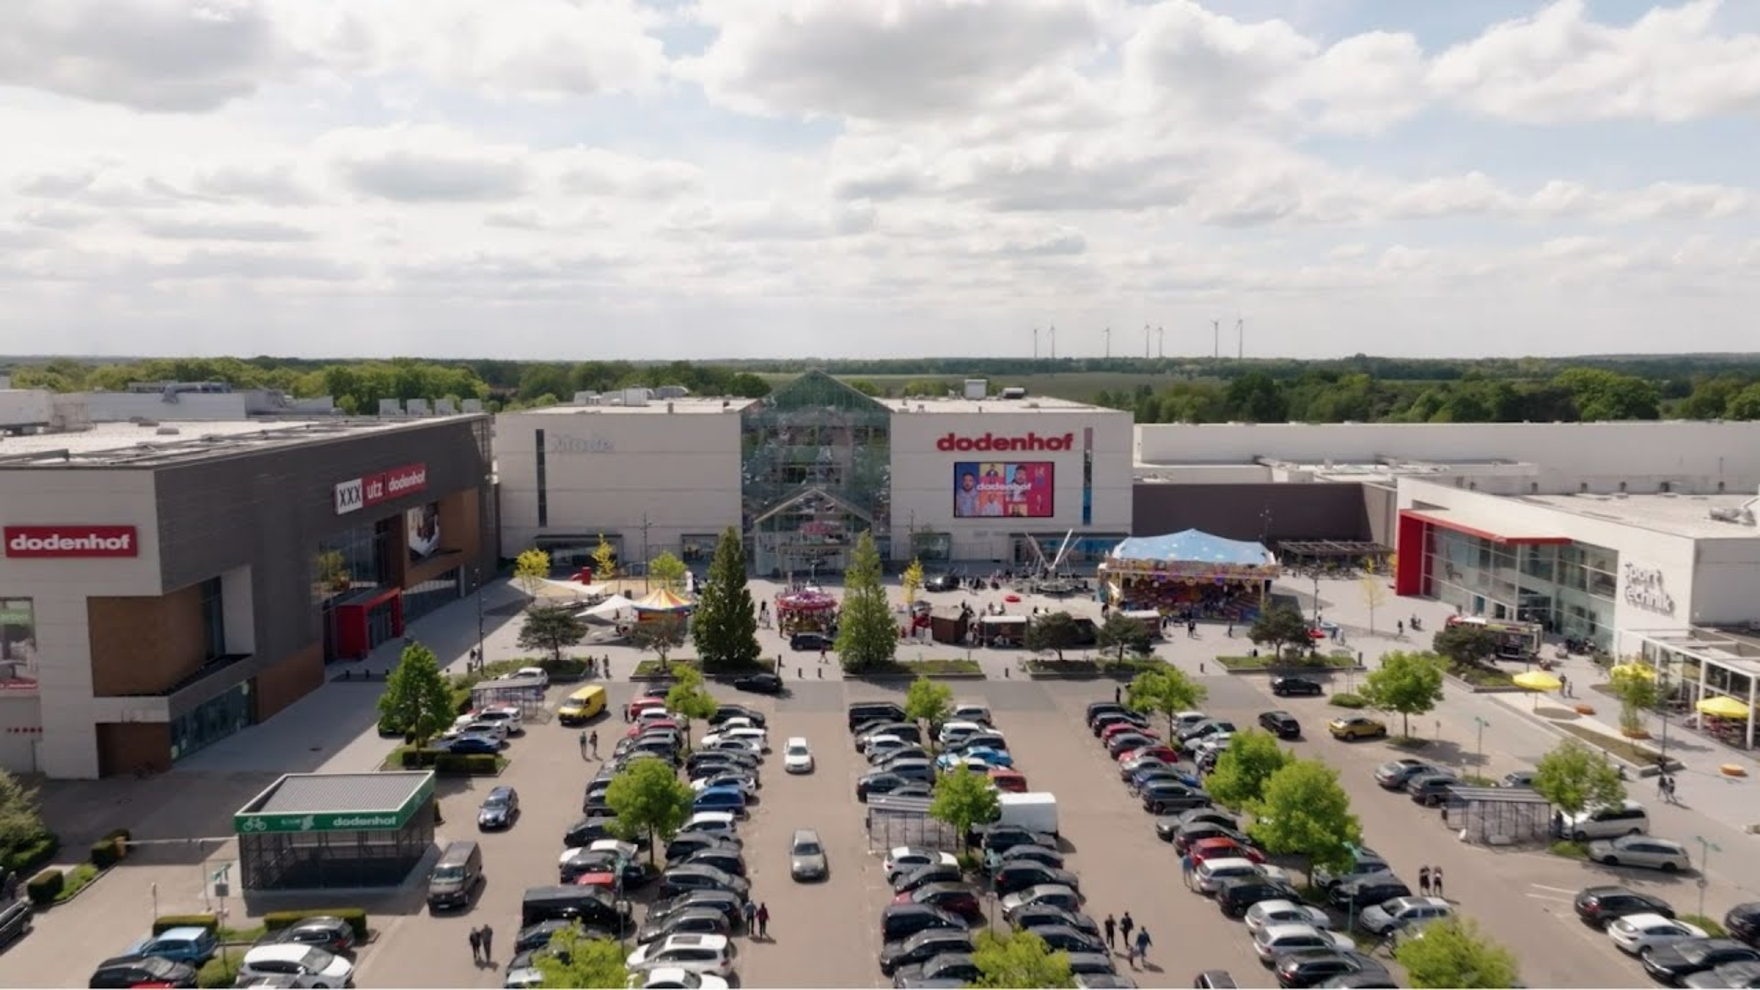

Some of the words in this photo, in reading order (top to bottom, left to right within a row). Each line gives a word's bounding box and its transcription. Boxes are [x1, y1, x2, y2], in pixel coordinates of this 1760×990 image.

[937, 432, 1073, 451] dodenhof
[389, 469, 425, 492] dodenhof
[977, 482, 1032, 491] dodenhof
[10, 533, 130, 550] dodenhof
[1623, 585, 1673, 613] echnik
[333, 816, 397, 826] dodenhof
